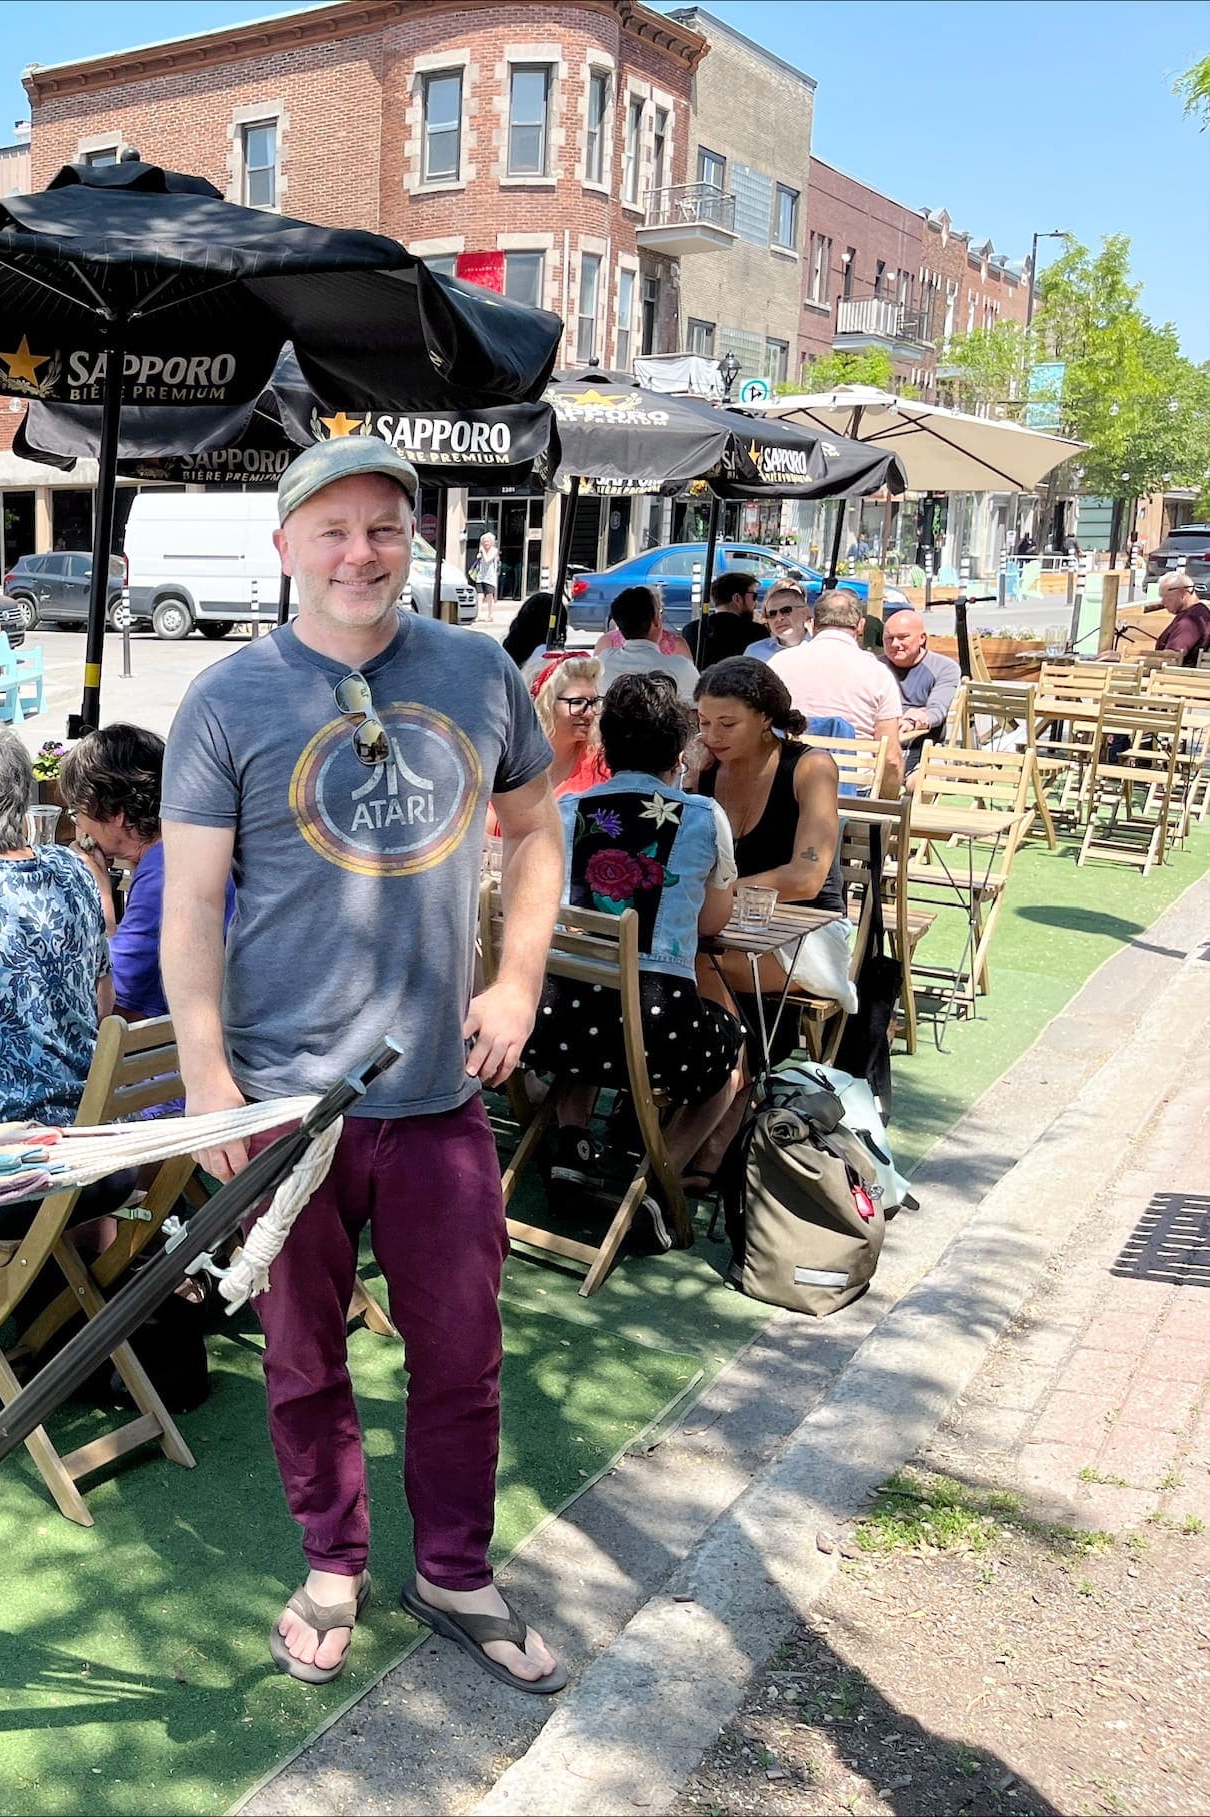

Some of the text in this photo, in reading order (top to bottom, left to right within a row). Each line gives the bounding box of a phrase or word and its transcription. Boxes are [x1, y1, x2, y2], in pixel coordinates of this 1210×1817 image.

[133, 386, 226, 400] PREMIUM
[376, 415, 511, 454] SAPPORO
[429, 453, 510, 463] PREMIUM
[764, 447, 807, 475] SAPPORO
[351, 794, 434, 831] ATARI
